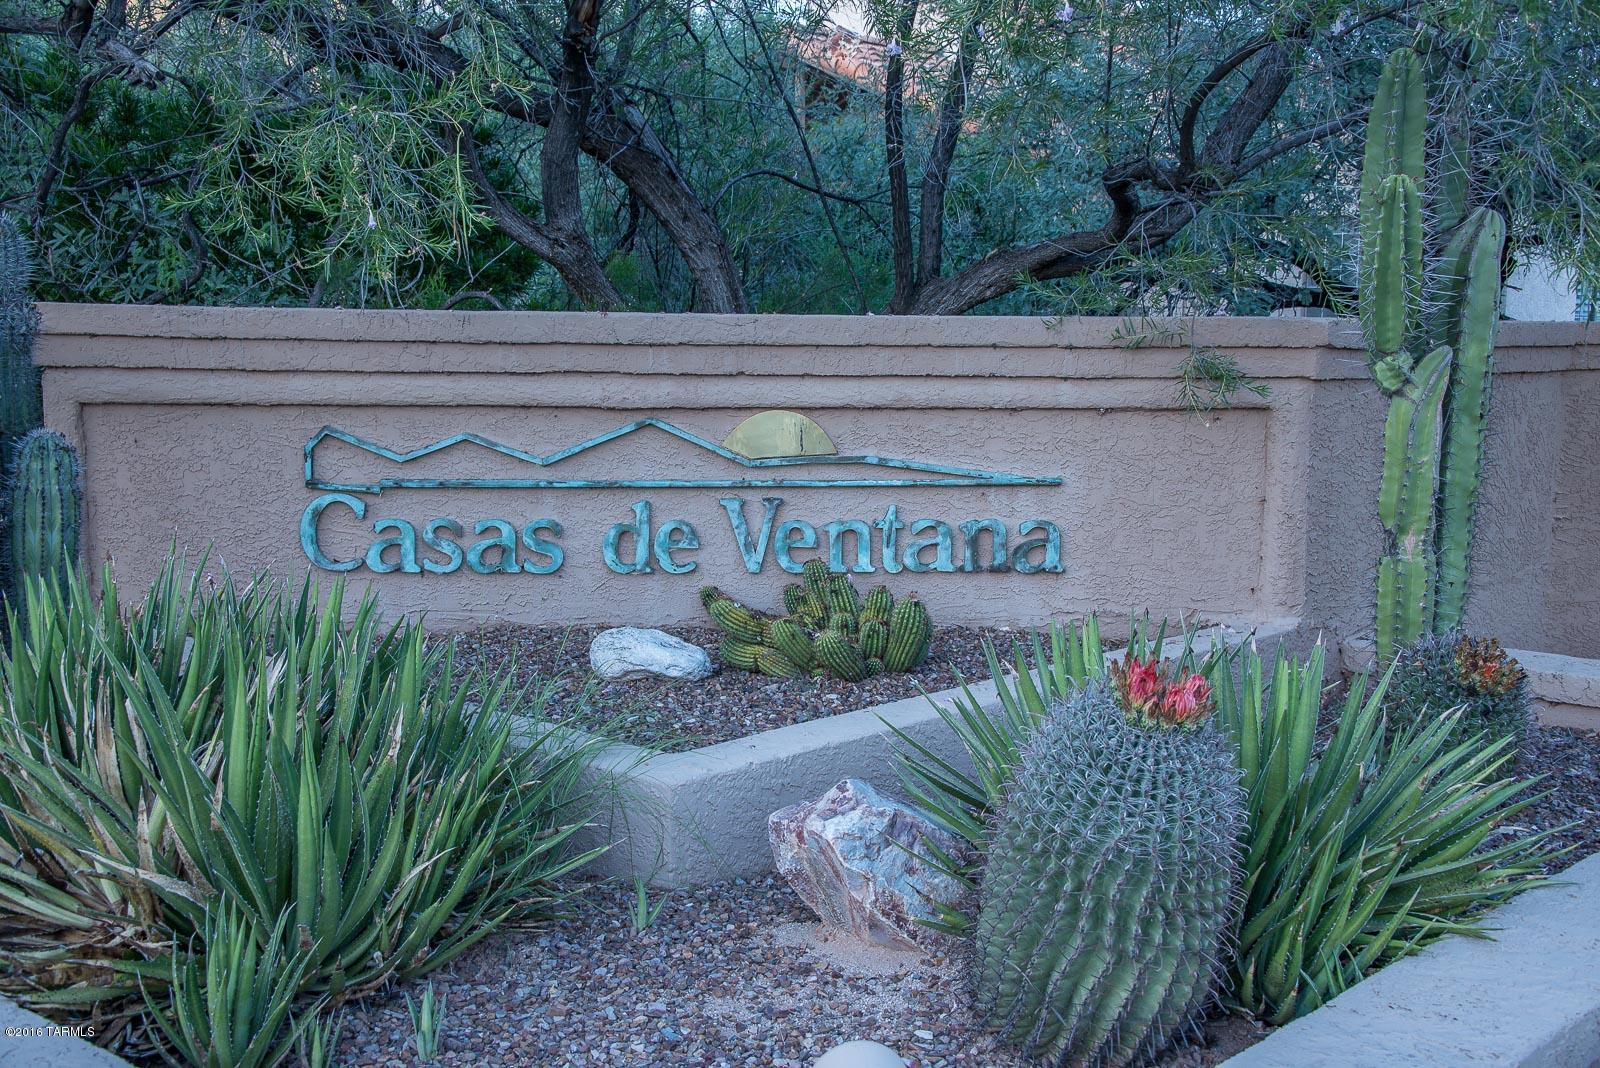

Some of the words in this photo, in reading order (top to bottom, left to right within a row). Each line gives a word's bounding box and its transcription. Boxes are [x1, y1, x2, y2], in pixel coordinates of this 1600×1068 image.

[300, 493, 564, 575] Casas
[603, 500, 699, 574] de
[719, 497, 1064, 575] Ventana
